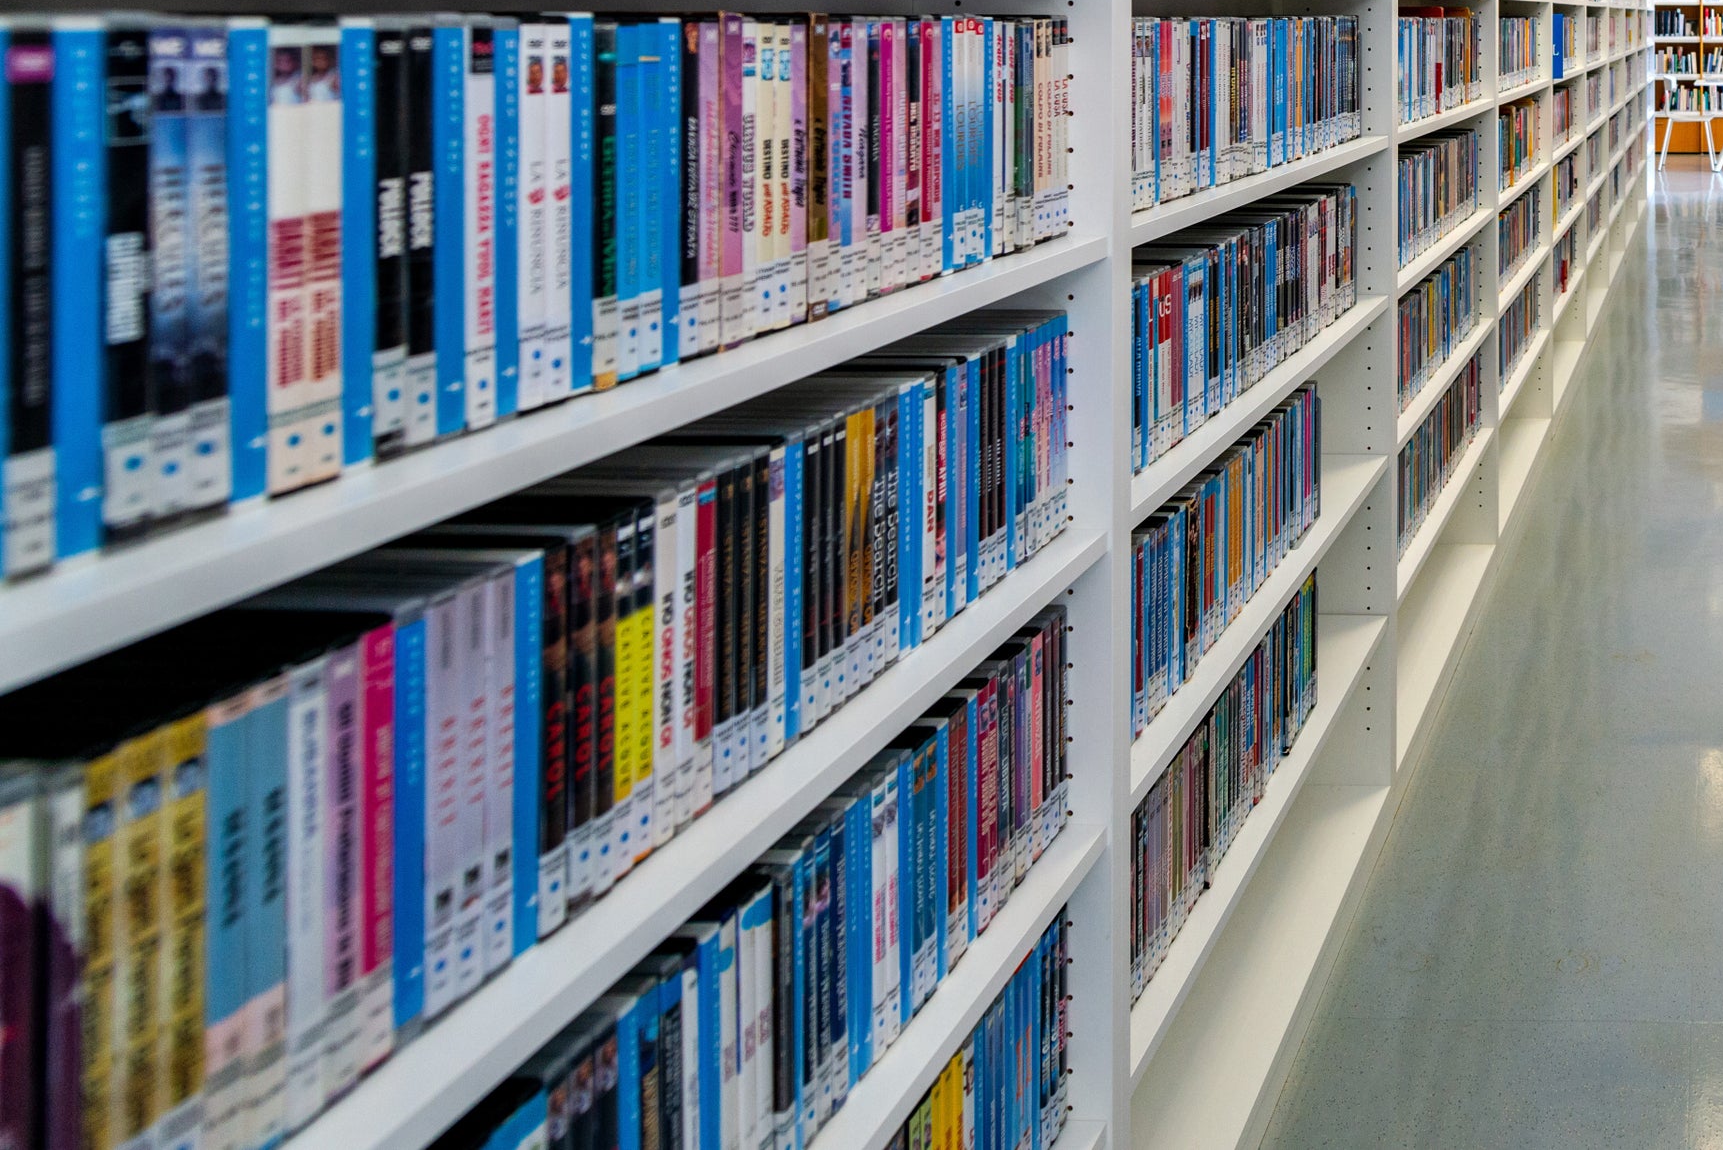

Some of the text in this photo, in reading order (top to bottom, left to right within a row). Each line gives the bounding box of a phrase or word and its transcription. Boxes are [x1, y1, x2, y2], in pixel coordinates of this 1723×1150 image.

[874, 475, 885, 602] The Search
[887, 467, 899, 592] The Search
[546, 702, 564, 801] CAROL
[576, 684, 592, 782] CAROL
[599, 676, 614, 770] CAROL
